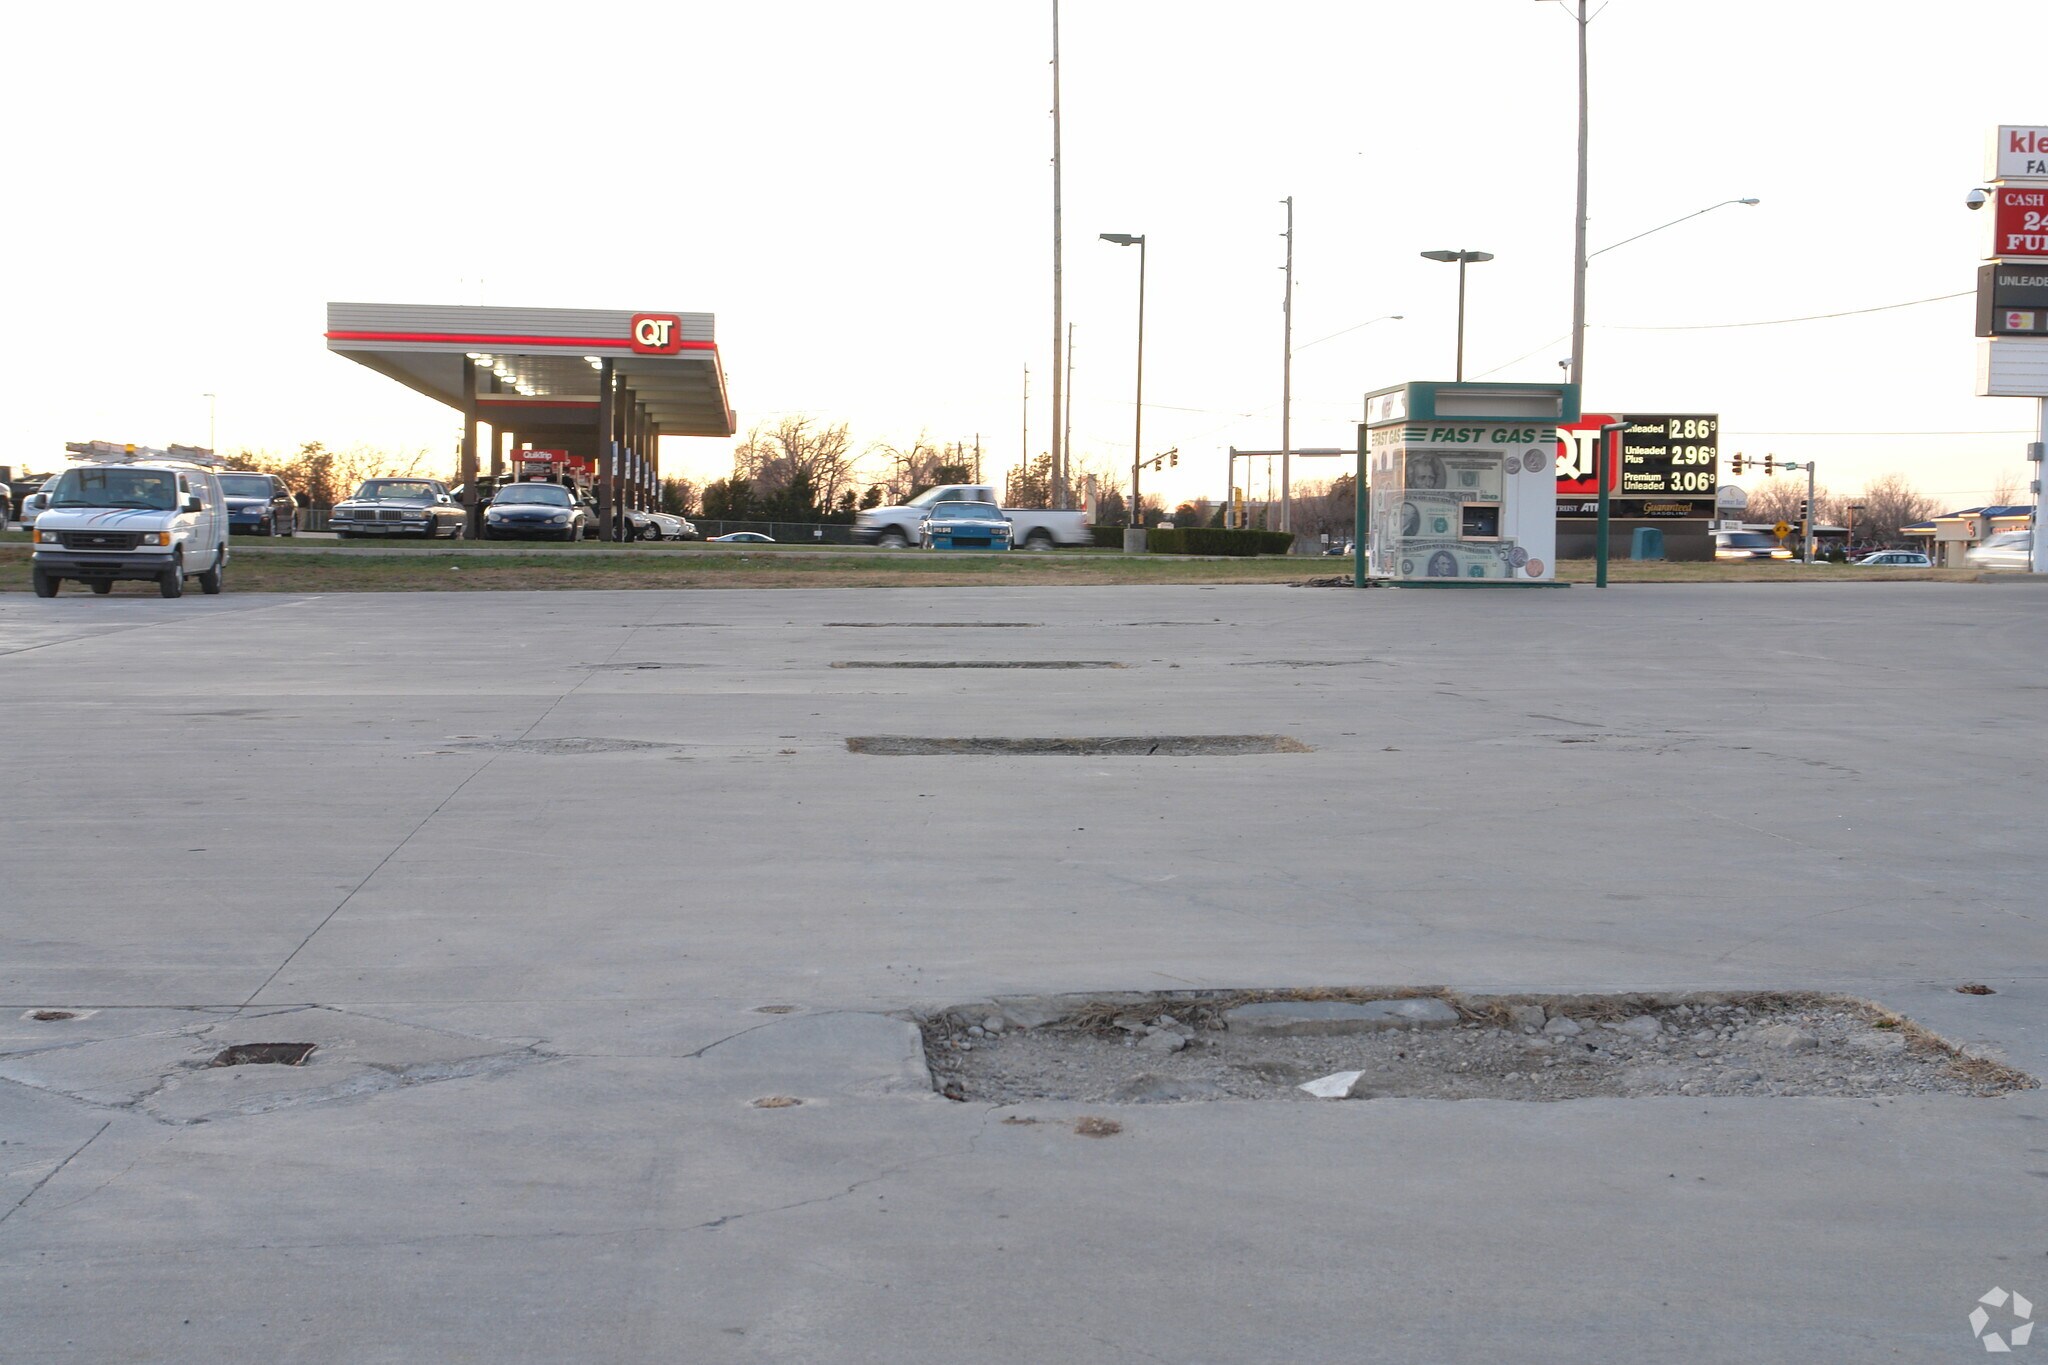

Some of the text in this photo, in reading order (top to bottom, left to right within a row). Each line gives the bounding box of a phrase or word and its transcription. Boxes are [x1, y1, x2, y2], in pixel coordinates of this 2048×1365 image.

[2010, 130, 2048, 153] kle
[2026, 160, 2048, 174] FA
[2005, 193, 2044, 206] CASH
[635, 319, 673, 347] QT
[1430, 428, 1536, 443] FAST GAS
[523, 451, 553, 461] QuikTrip
[1556, 427, 1600, 480] QT
[1625, 446, 1667, 455] Unleaded
[1625, 454, 1644, 464] Plus
[1624, 473, 1662, 481] Premium
[1624, 481, 1665, 490] Unleaded
